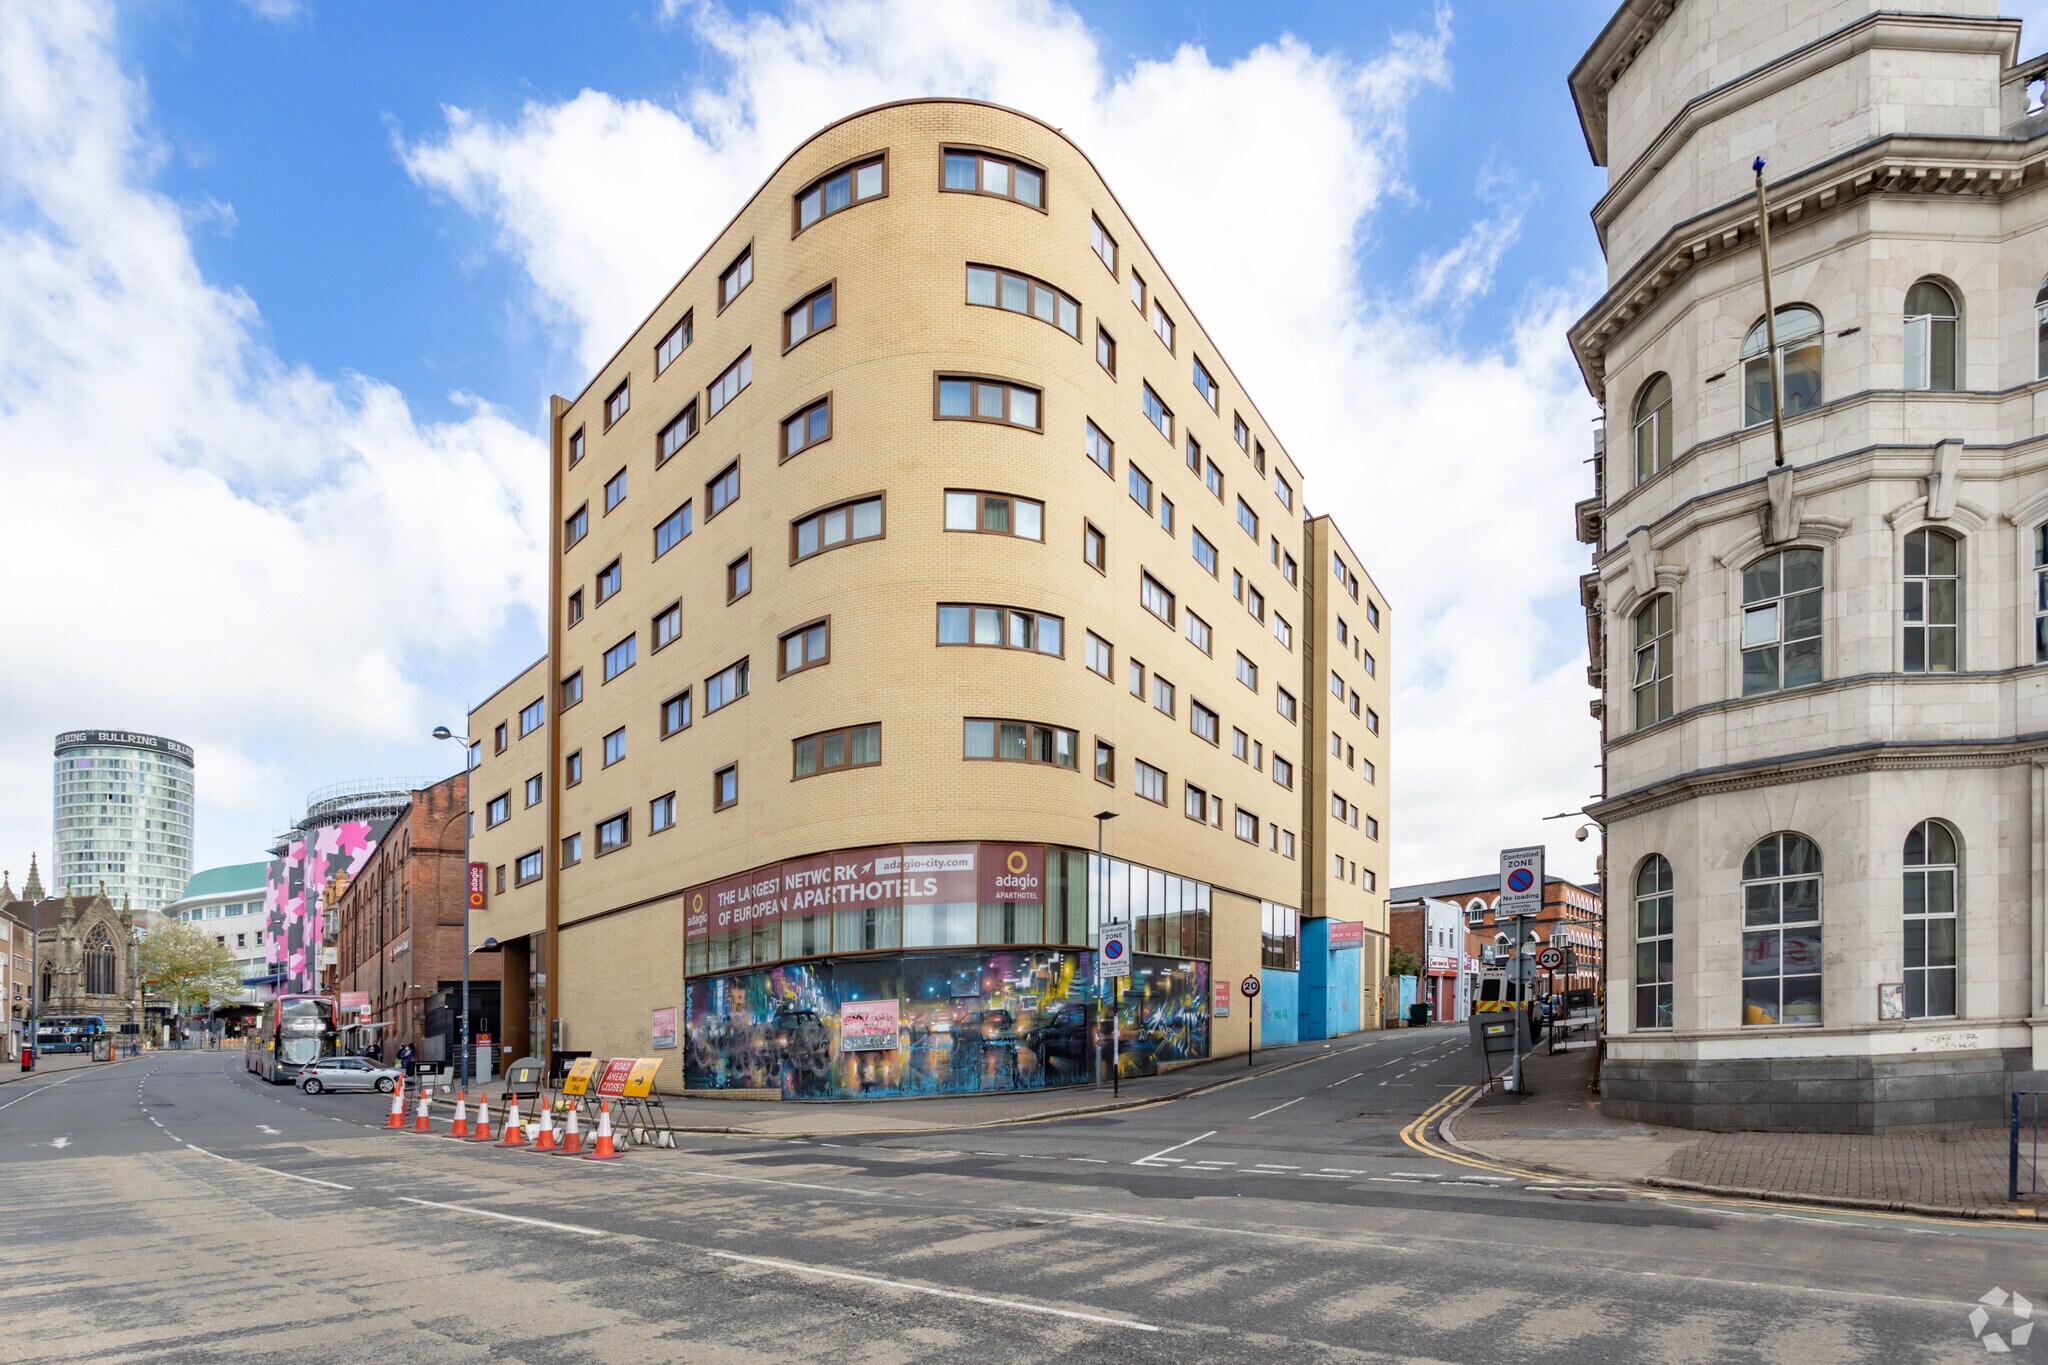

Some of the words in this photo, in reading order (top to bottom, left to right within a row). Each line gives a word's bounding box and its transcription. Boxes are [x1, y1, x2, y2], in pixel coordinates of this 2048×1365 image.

[98, 732, 158, 747] BULLRING
[1502, 851, 1539, 861] Controlled
[884, 857, 968, 871] adagio-city.com
[1508, 858, 1533, 868] ZONE
[471, 867, 481, 892] adagio
[995, 874, 1038, 891] adagio
[718, 890, 736, 907] THE
[738, 878, 780, 902] LARGEST
[785, 864, 858, 890] NETWORK
[718, 911, 732, 926] OF
[733, 896, 788, 924] EUROPEAN
[793, 877, 938, 910] APARTHOTELS
[1515, 893, 1540, 901] loading
[687, 912, 708, 927] adagio
[1542, 953, 1559, 963] 20
[1244, 981, 1258, 990] 20
[613, 1062, 631, 1071] ROAD
[606, 1072, 628, 1081] AHEAD
[601, 1082, 625, 1092] CLOSED
